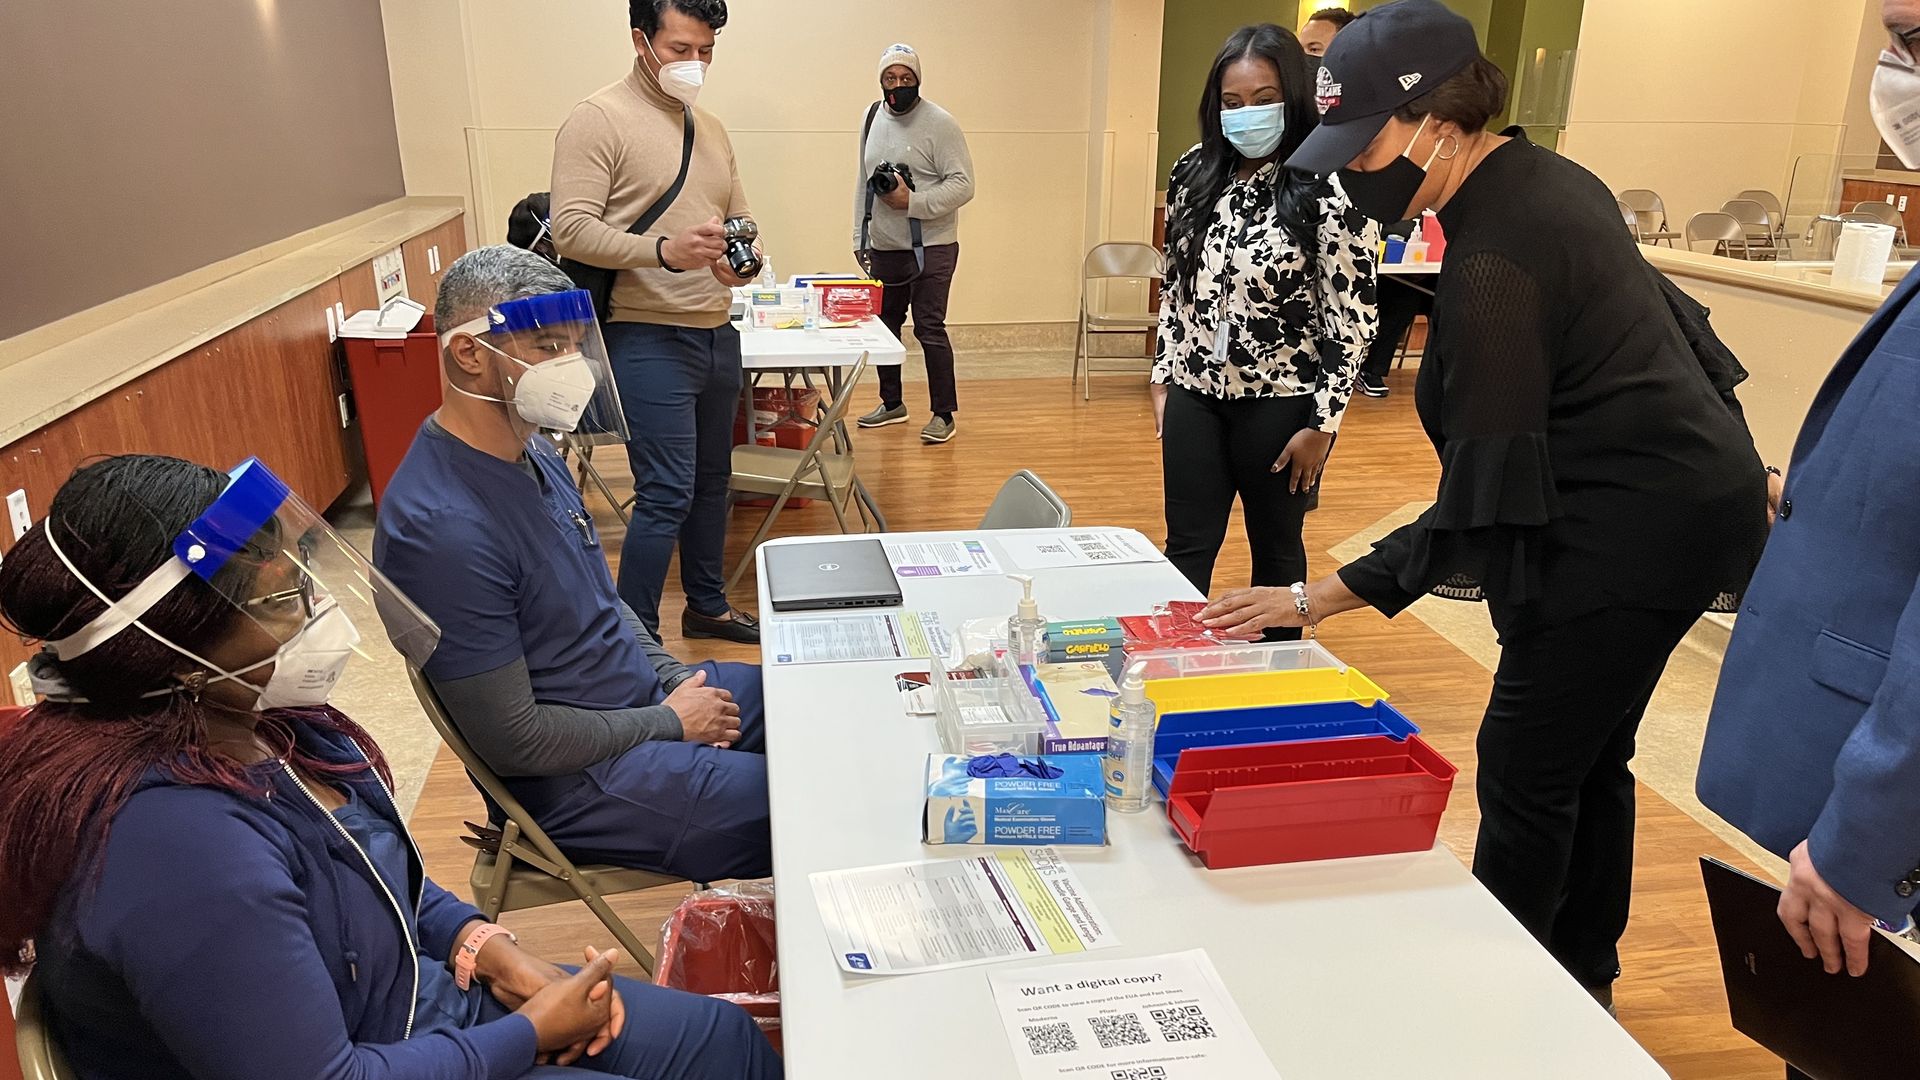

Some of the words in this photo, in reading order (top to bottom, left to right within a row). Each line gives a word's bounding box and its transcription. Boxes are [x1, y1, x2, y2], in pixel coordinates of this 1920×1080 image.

[1062, 627, 1107, 636] GARFIELD
[1065, 643, 1110, 654] GARFIELD
[1051, 742, 1066, 752] True
[1068, 741, 1104, 752] Advantage
[994, 826, 1036, 835] POWDER
[1037, 825, 1062, 835] FREE
[1062, 878, 1077, 897] Vaccine
[1051, 879, 1066, 897] Needle
[1062, 896, 1077, 914] Gauge
[1073, 912, 1084, 925] and
[1080, 922, 1096, 943] Length
[1020, 984, 1061, 997] Want
[1064, 983, 1073, 991] a
[1077, 975, 1121, 990] digital
[1124, 973, 1162, 985] copy?
[1136, 1056, 1175, 1064] information
